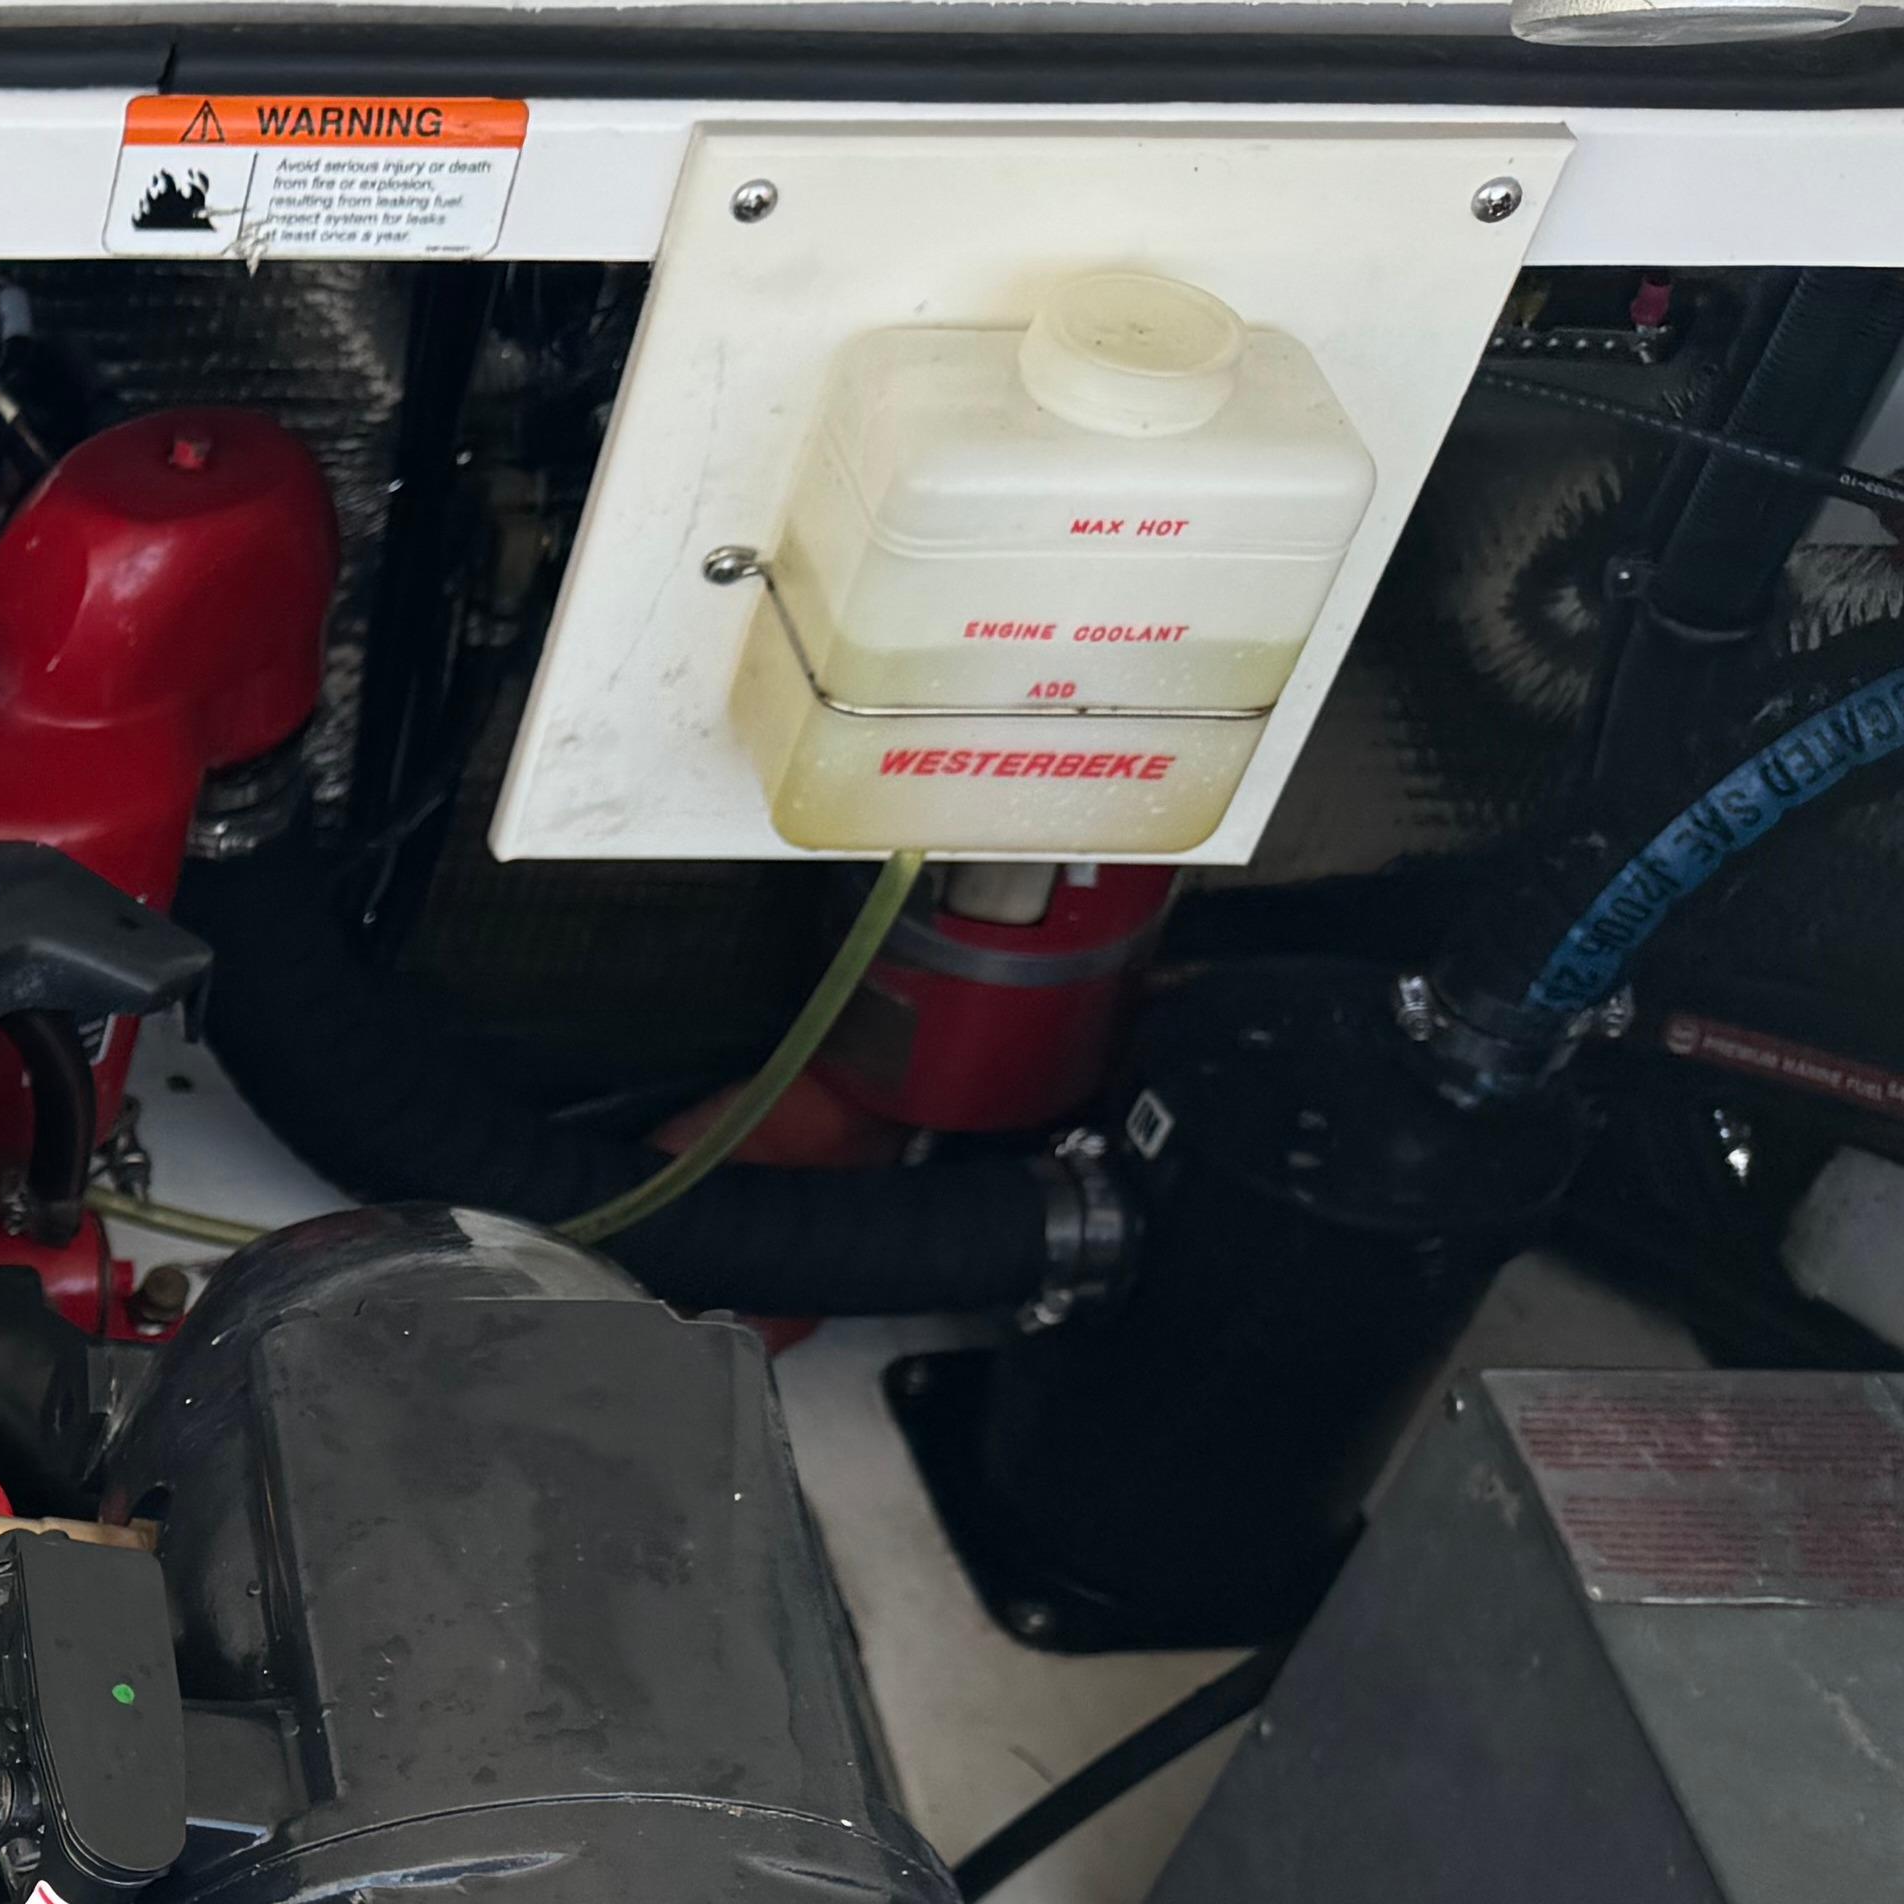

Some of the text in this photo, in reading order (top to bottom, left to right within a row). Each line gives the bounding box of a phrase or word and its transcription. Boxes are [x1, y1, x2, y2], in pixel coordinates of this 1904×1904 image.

[256, 107, 443, 137] WARNING
[277, 158, 492, 176] Avoid serious injury or death
[273, 177, 307, 190] from
[311, 177, 335, 190] fire
[339, 179, 355, 190] or
[270, 195, 333, 209] resulting
[338, 196, 372, 208] from
[376, 196, 431, 210] leaking
[324, 214, 377, 228] system
[382, 214, 402, 225] for
[406, 214, 446, 225] leaks
[281, 230, 316, 242] least
[1071, 519, 1190, 536] MAX HOT
[964, 621, 1190, 643] ENGINE COOLANT
[1027, 682, 1077, 699] ADD
[880, 748, 1177, 781] WESTERBEKE
